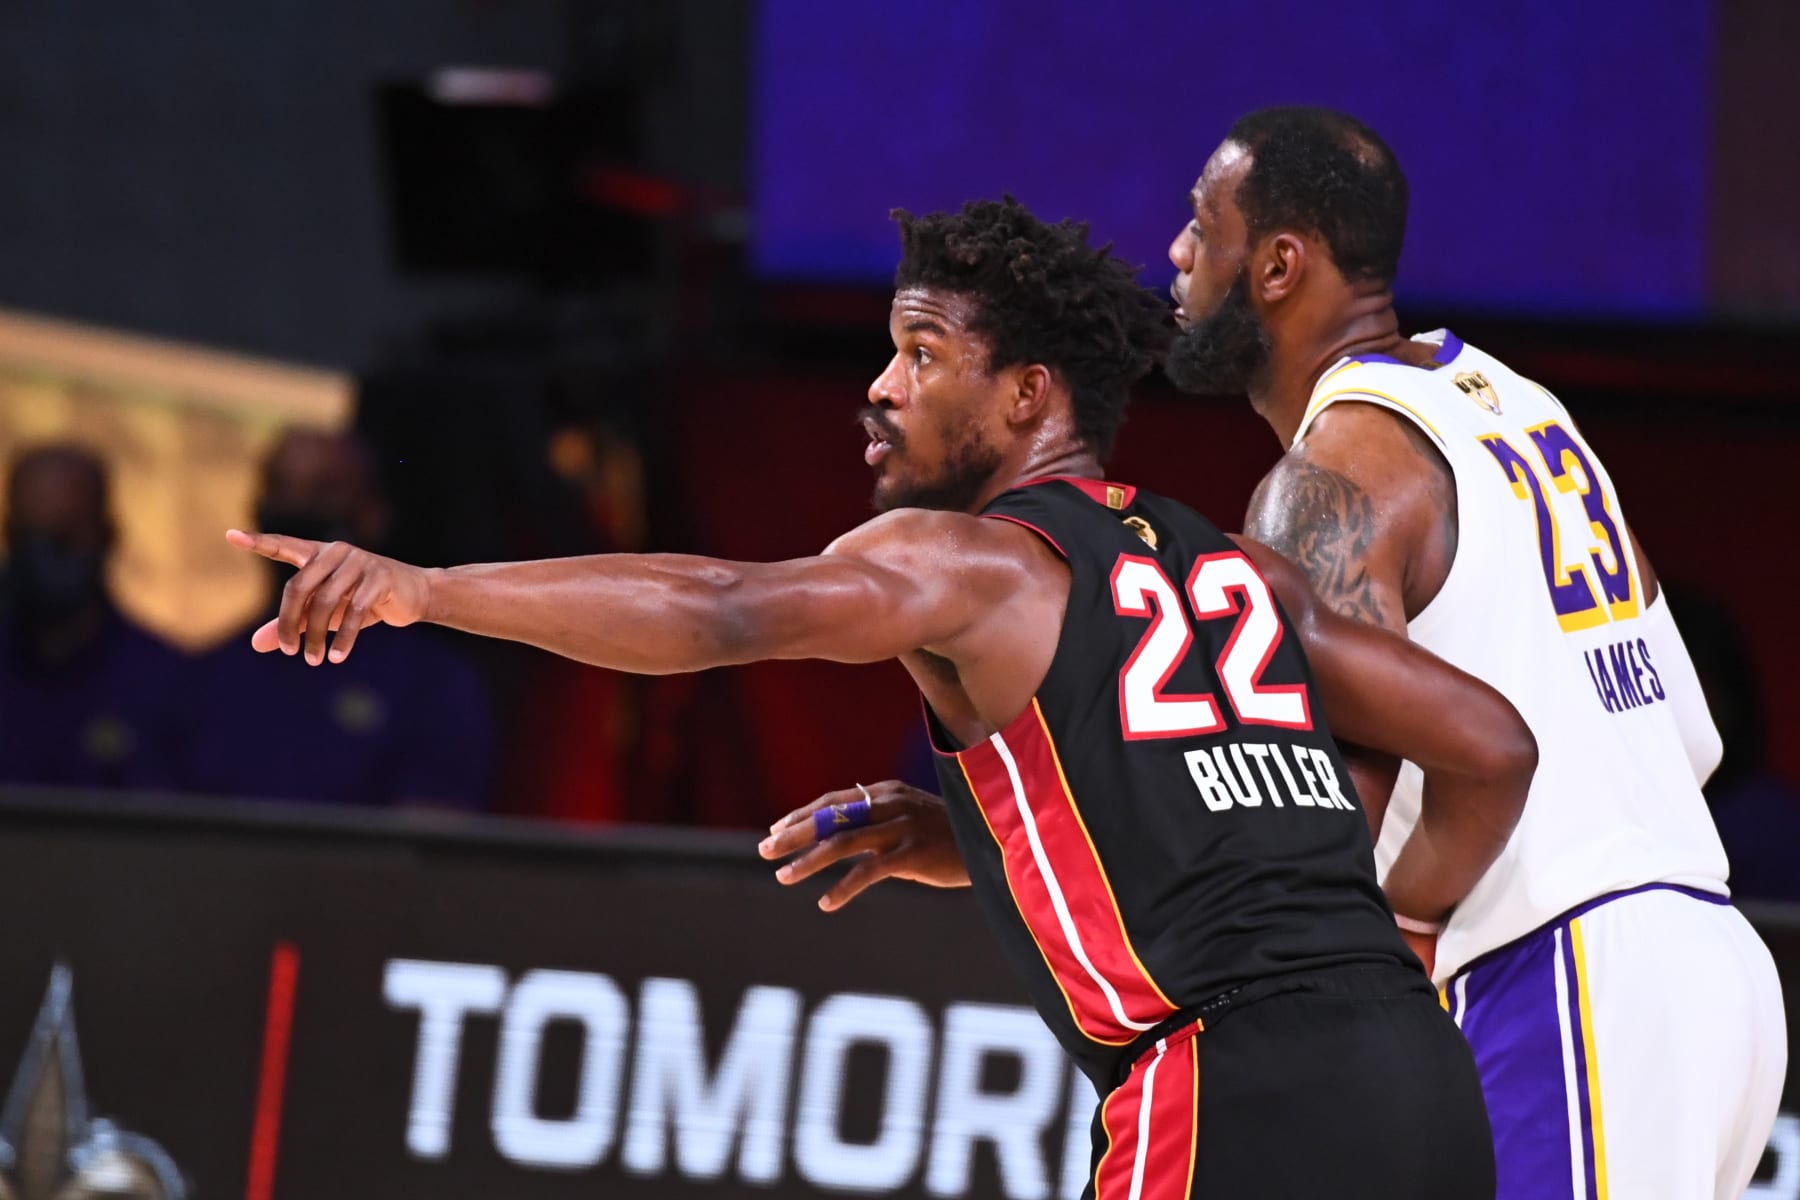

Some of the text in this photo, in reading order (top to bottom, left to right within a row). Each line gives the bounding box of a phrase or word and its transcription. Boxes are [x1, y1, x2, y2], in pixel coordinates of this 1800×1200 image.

[1476, 419, 1639, 633] 23
[1109, 550, 1314, 741] 22
[1584, 637, 1666, 714] JAMES
[1184, 743, 1356, 812] BUTLER
